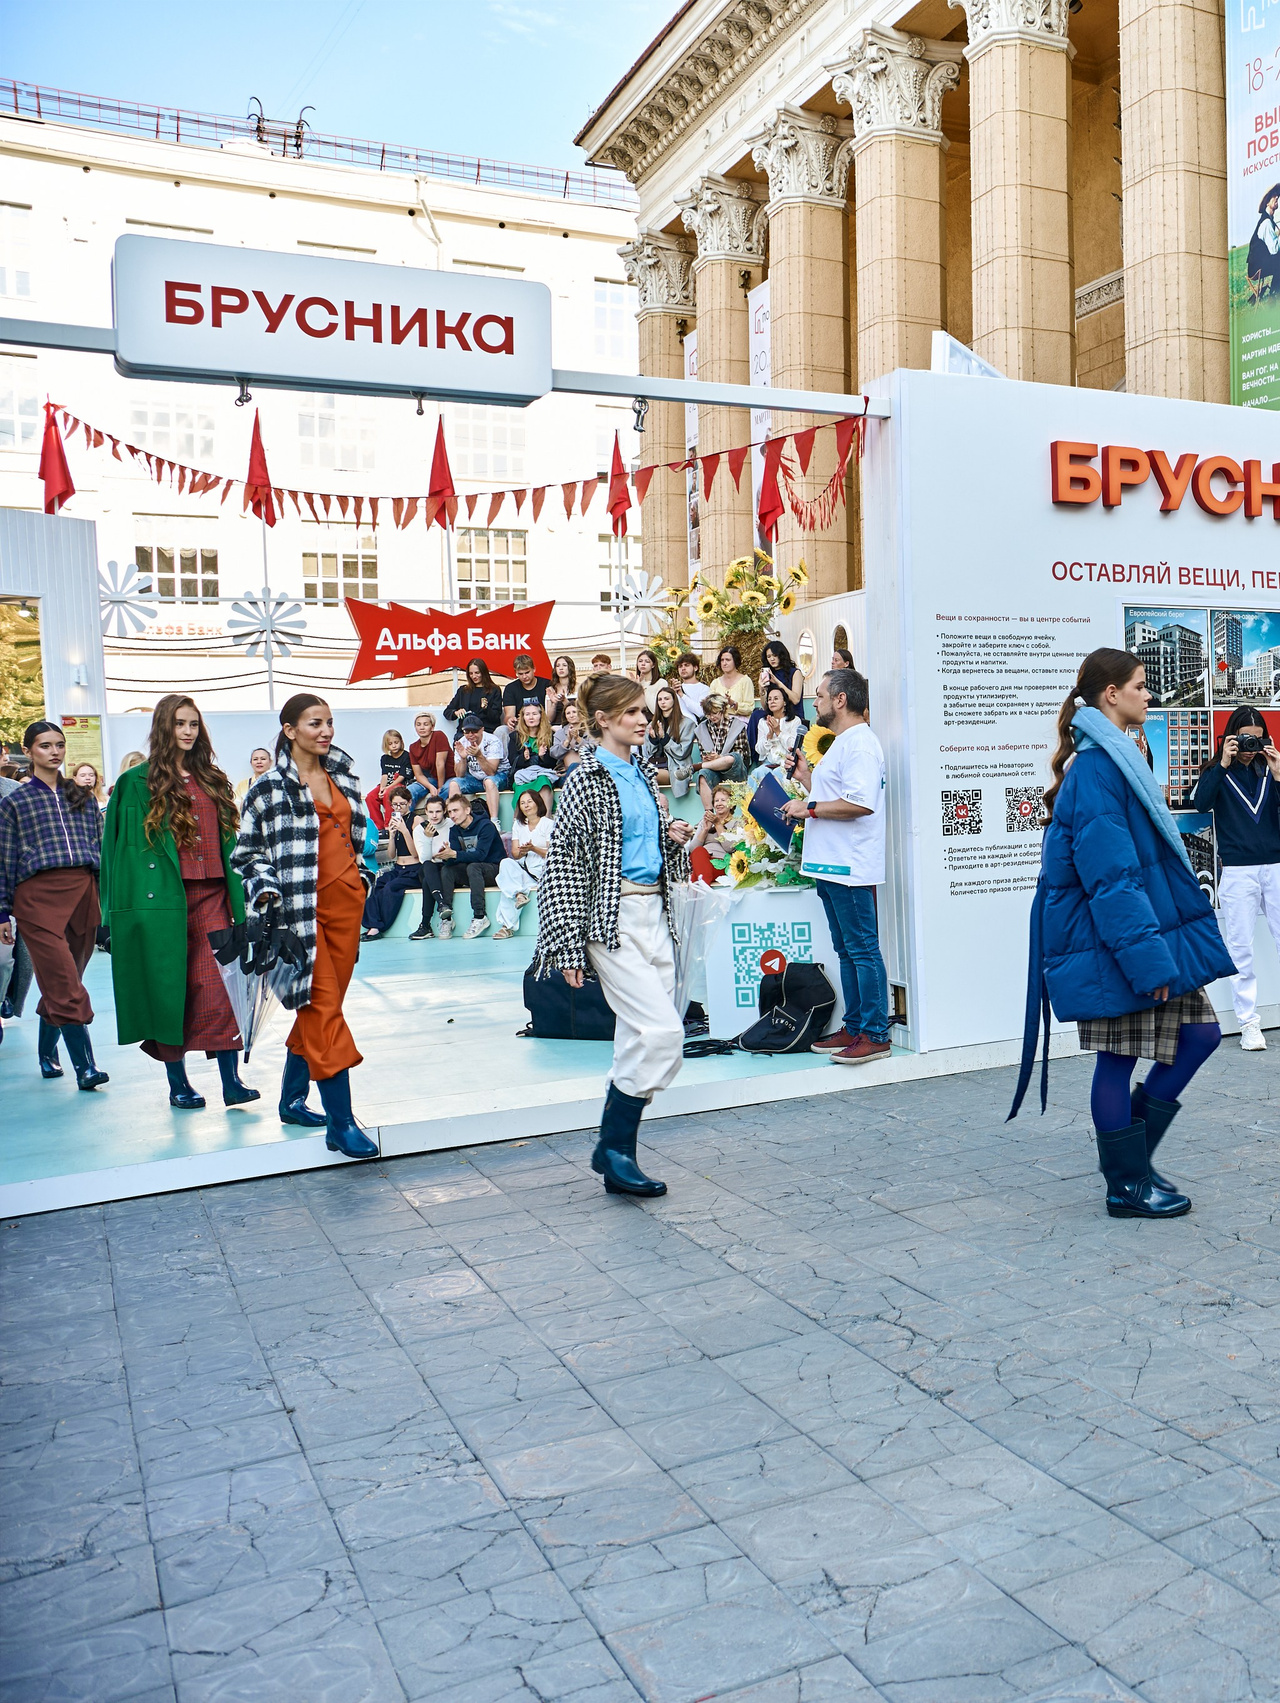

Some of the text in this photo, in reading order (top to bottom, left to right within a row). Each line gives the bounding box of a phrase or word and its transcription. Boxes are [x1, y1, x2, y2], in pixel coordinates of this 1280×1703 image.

[1242, 327, 1272, 344] ХОРИСТЫ
[1242, 347, 1267, 362] МАРТИН
[1242, 370, 1254, 380] ВАН
[1256, 365, 1268, 376] ГОГ.
[1270, 362, 1278, 372] НА
[1242, 374, 1276, 391] ВЕЧНОСТИ
[1242, 395, 1268, 408] НАЧАЛО
[1052, 561, 1171, 584] ОСТАВЛЯЙ
[1178, 567, 1245, 591] ВЕЩИ,
[1129, 610, 1185, 620] Европейский берег
[136, 623, 222, 637] льфа Банк
[376, 627, 532, 660] Альфа Банк
[949, 700, 976, 708] забытые
[950, 888, 988, 896] Количество
